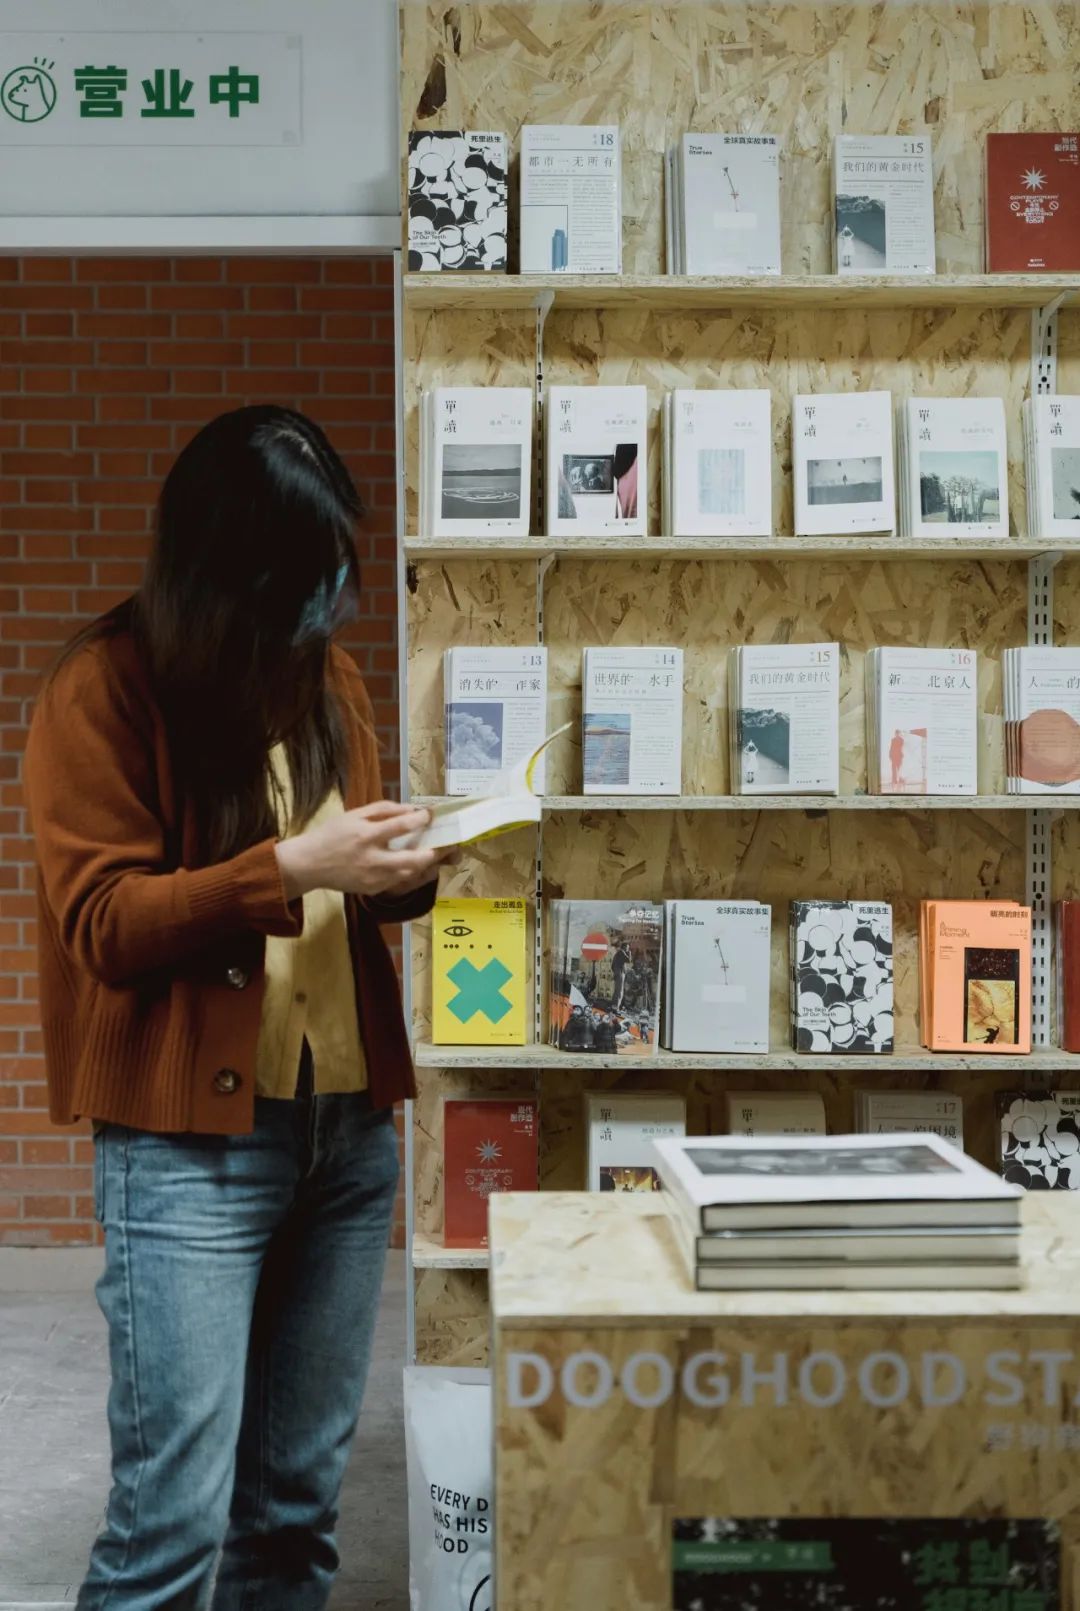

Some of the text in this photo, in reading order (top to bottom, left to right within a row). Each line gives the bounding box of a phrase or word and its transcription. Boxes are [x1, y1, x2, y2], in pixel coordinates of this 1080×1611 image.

[74, 65, 260, 118] 营业中
[600, 133, 614, 146] 18
[910, 143, 925, 154] 15
[842, 161, 925, 174] 我们的黄金时代
[530, 655, 542, 666] 13
[663, 654, 676, 665] 14
[816, 651, 831, 663] 15
[957, 654, 971, 665] 16
[459, 678, 498, 691] 消失的
[594, 672, 676, 687] 世界的 水手
[748, 671, 831, 686] 我们的黄金时代
[888, 673, 972, 688] 新 北京人
[942, 1103, 957, 1115] 17
[506, 1351, 1080, 1408] DOOGHOOD ST
[430, 1483, 470, 1511] EVERY
[432, 1506, 488, 1534] HAS HIS
[434, 1528, 469, 1554] HOOD
